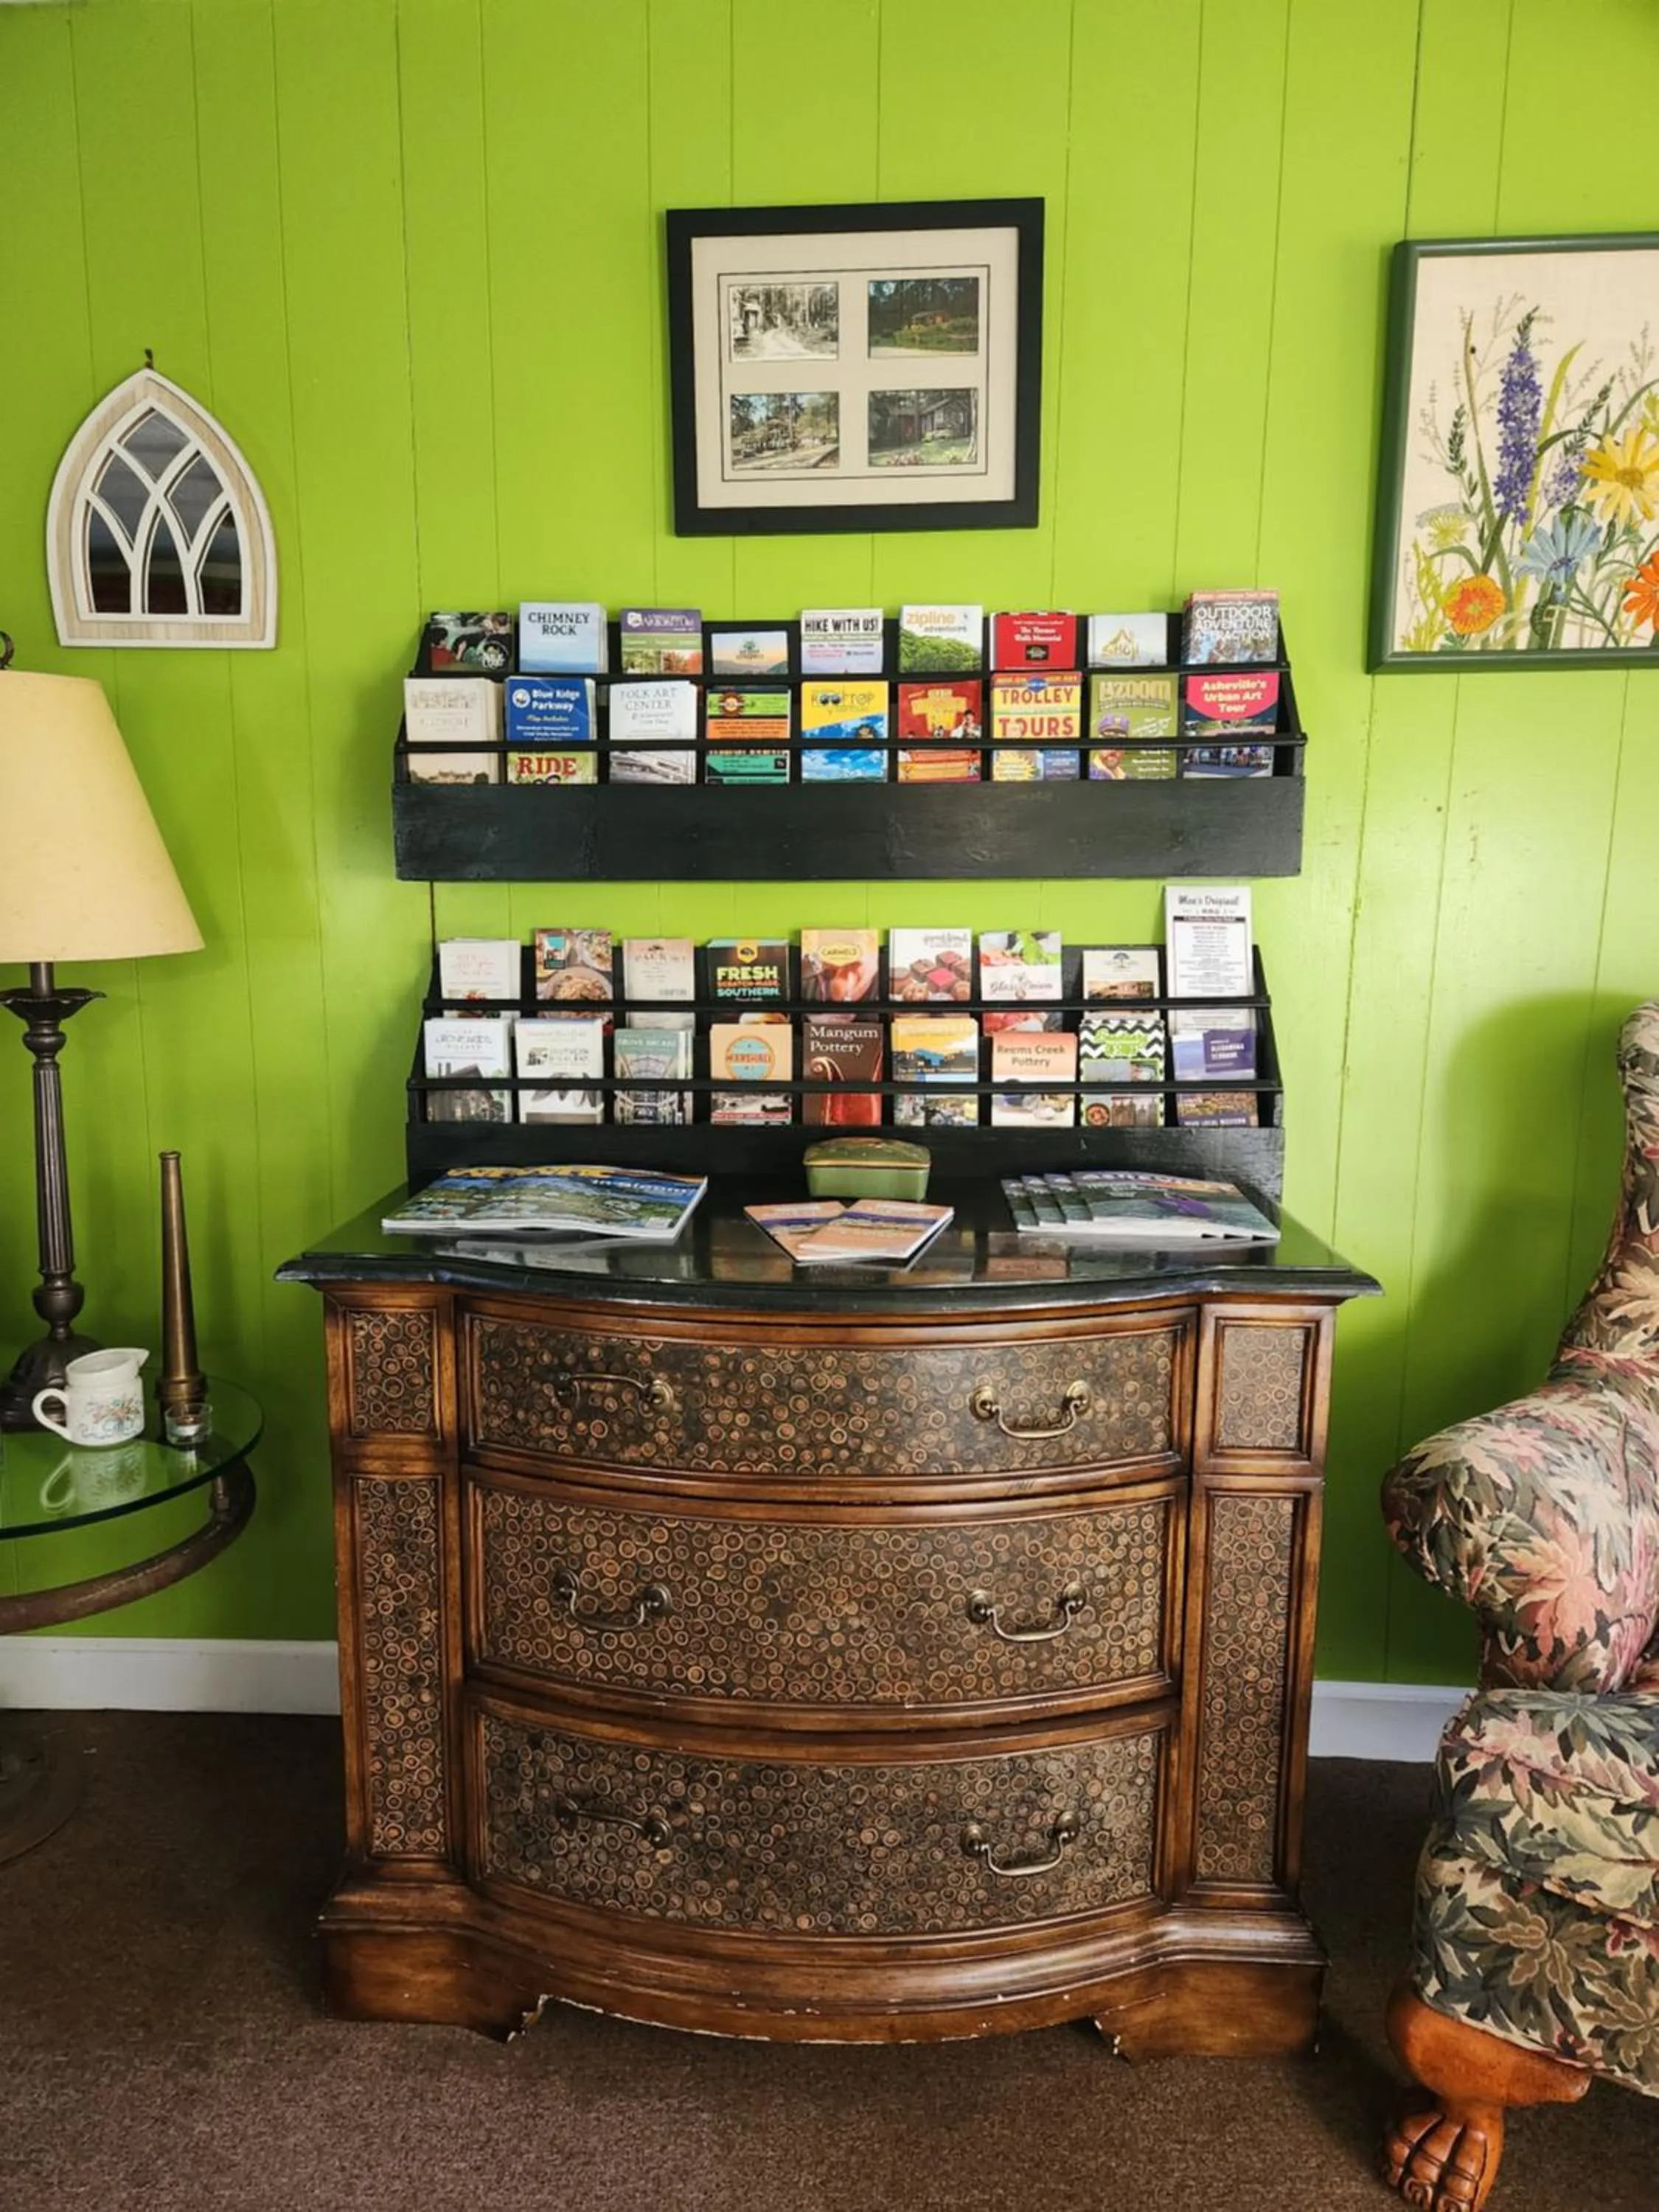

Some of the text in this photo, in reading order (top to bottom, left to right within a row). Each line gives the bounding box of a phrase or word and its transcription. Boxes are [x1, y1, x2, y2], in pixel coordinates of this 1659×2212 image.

[527, 611, 590, 625] CHIMNEY
[905, 610, 956, 627] zipline
[1194, 605, 1273, 620] OUTDOOR
[541, 625, 577, 636] ROCK
[804, 617, 879, 633] HIKE WITH US!
[1201, 678, 1267, 692] Asheville's
[532, 687, 553, 699] Blue
[620, 686, 678, 699] FOLK ART
[999, 688, 1075, 705] TROLLEY
[1203, 690, 1263, 703] Urban Art
[532, 700, 574, 713] Parkway
[625, 700, 673, 711] CENTER
[1218, 703, 1248, 713] Tour
[998, 717, 1074, 737] TOURS
[518, 757, 577, 776] RIDE
[717, 965, 779, 980] FRESH
[810, 1025, 879, 1042] Mangum
[810, 1041, 865, 1056] Pottery
[1034, 1044, 1066, 1054] Creek
[1011, 1057, 1051, 1068] Pottery
